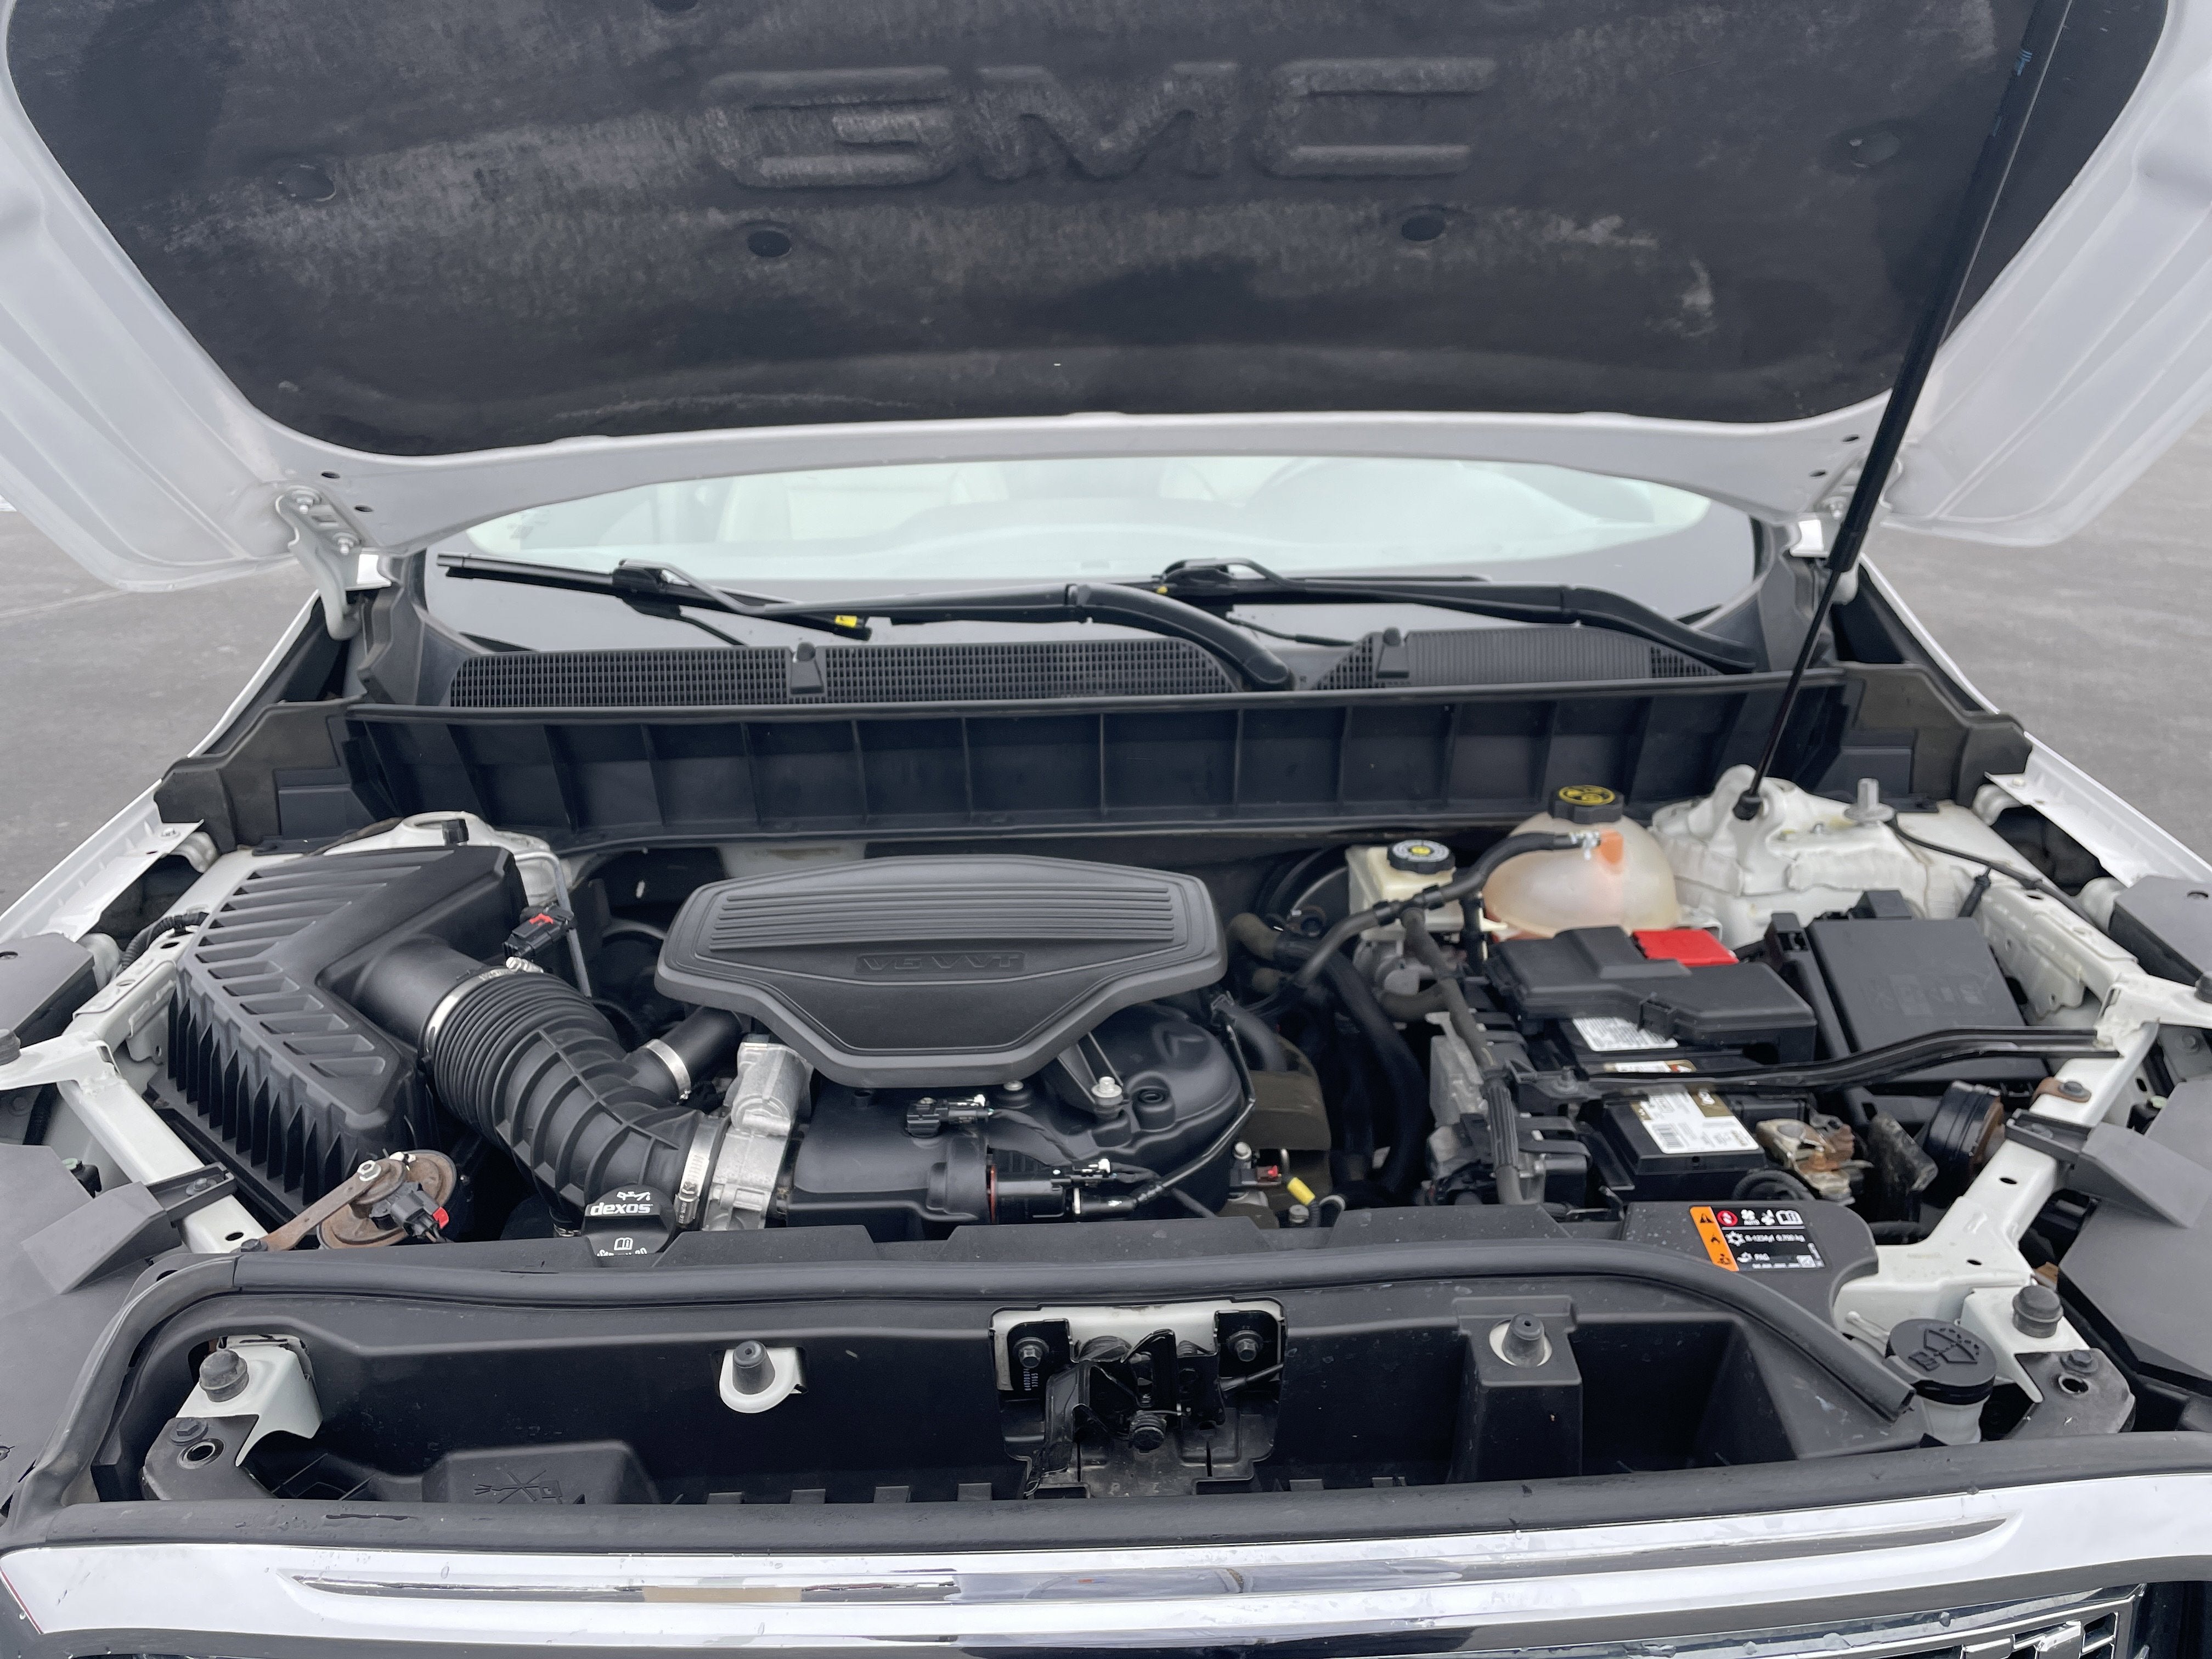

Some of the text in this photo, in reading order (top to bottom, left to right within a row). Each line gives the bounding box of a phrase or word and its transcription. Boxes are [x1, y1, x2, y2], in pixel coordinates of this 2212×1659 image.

[701, 56, 1498, 189] GMC
[863, 955, 1020, 970] V6 VVT
